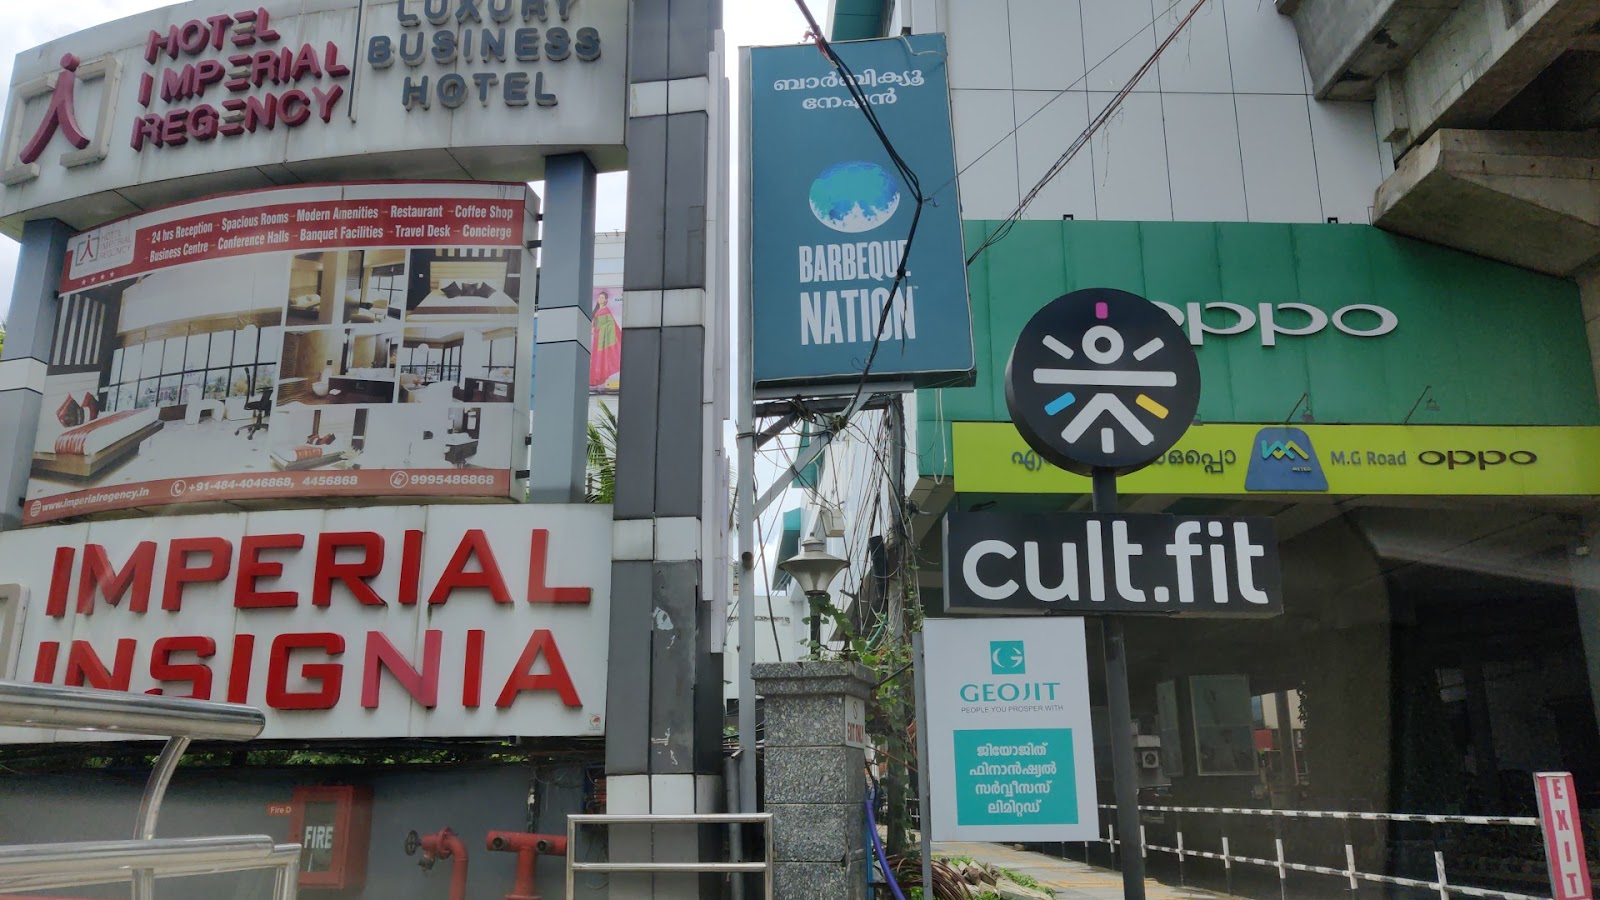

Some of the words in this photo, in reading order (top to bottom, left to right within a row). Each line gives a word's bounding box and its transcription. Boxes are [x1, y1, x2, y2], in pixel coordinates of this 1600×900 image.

[397, 0, 577, 26] LUXURY
[144, 7, 281, 65] HOTEL
[367, 27, 601, 69] BUSINESS
[137, 40, 350, 108] IMPERIAL
[402, 71, 559, 111] HOTEL
[130, 83, 344, 152] REGENCY
[149, 247, 182, 263] Business
[183, 241, 209, 256] Centre
[217, 235, 265, 250] Conference
[267, 229, 290, 244] Halls
[300, 227, 338, 243] Banquet
[340, 225, 384, 240] Facilities
[395, 224, 424, 237] Travel
[427, 224, 451, 237] Desk
[462, 224, 512, 240] Concierge
[151, 229, 161, 244] 24
[162, 229, 174, 241] hrs
[175, 221, 213, 238] Reception
[221, 215, 259, 233] Spacious
[260, 212, 289, 226] Rooms
[296, 208, 331, 222] Modern
[333, 205, 379, 220] Amenities
[390, 204, 443, 218] Restaurant
[455, 204, 487, 218] Coffee
[489, 205, 514, 221] Shop
[800, 286, 916, 346] NATION
[302, 475, 358, 486] 4456868
[410, 475, 494, 485] 9995486868
[1330, 450, 1362, 466] M.G
[1367, 450, 1407, 466] Road
[1418, 450, 1538, 471] oppo
[41, 487, 150, 511] www.imperialregency.in
[45, 529, 592, 618] IMPERIAL
[962, 520, 1269, 604] cult.fit
[33, 629, 583, 710] INSIGNIA
[960, 682, 1060, 702] GEOJIT
[961, 706, 989, 714] PEOPLE
[1008, 704, 1043, 713] PROSPER
[1044, 704, 1064, 712] WITH
[270, 806, 284, 814] Fire
[304, 826, 334, 849] FIRE
[1552, 779, 1577, 895] EXIT
